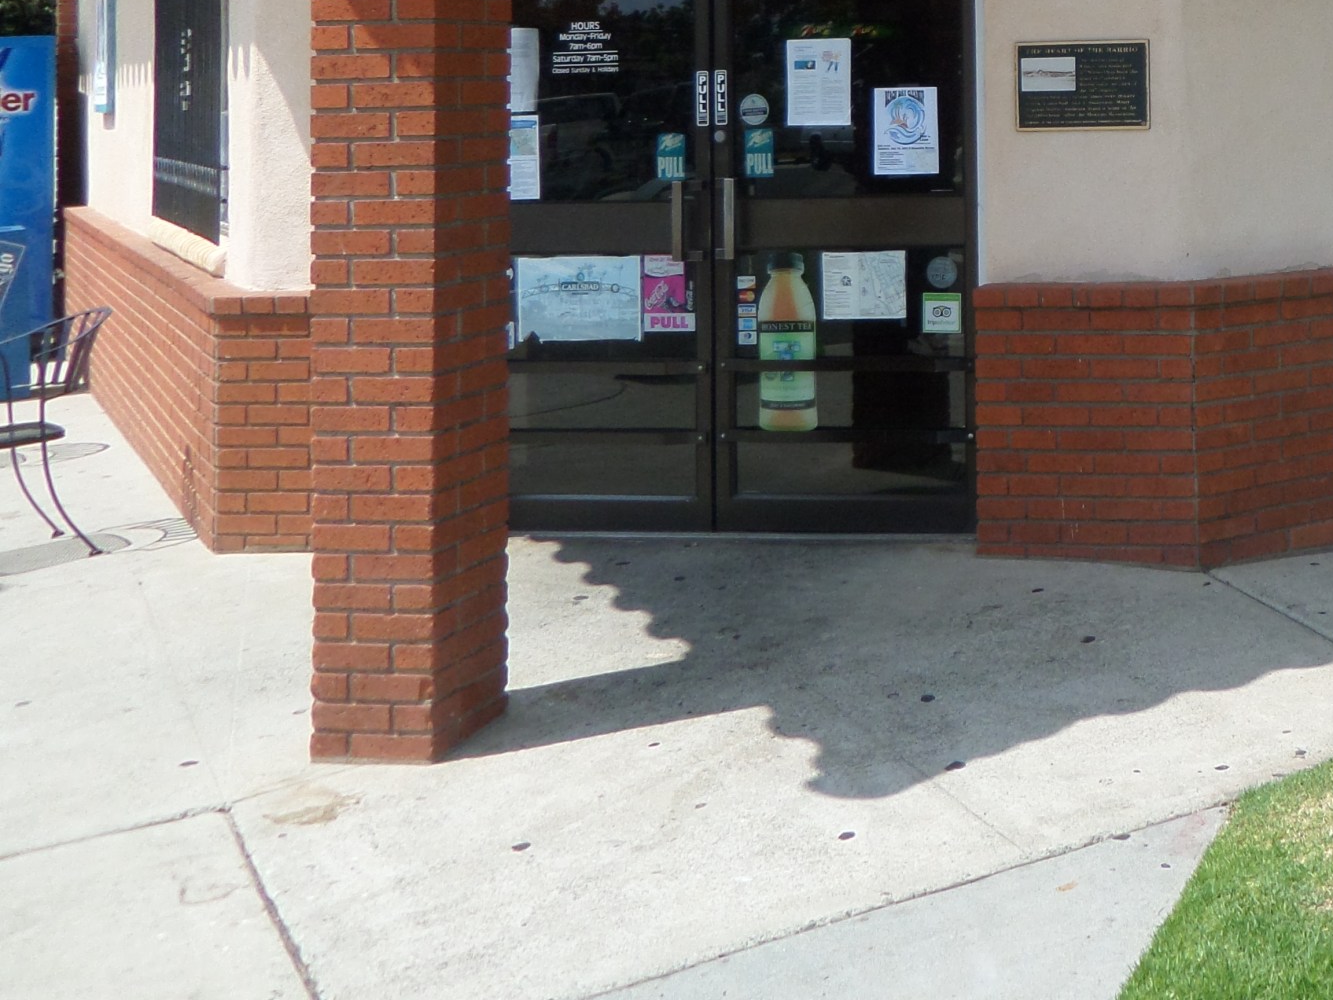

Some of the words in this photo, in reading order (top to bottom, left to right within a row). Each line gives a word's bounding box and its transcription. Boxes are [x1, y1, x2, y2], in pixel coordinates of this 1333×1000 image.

[571, 21, 601, 30] HOURS
[559, 32, 612, 41] Monday-Friday
[569, 42, 603, 51] 7am-6pm
[552, 55, 585, 63] Saturday
[586, 53, 619, 62] 7am-5pm
[699, 76, 707, 113] PULL
[717, 75, 725, 112] PULL
[0, 92, 36, 112] er
[657, 156, 685, 178] PULL
[746, 153, 774, 175] PULL
[650, 316, 689, 329] PULL
[761, 323, 795, 332] HONEST
[797, 322, 813, 331] TEA
